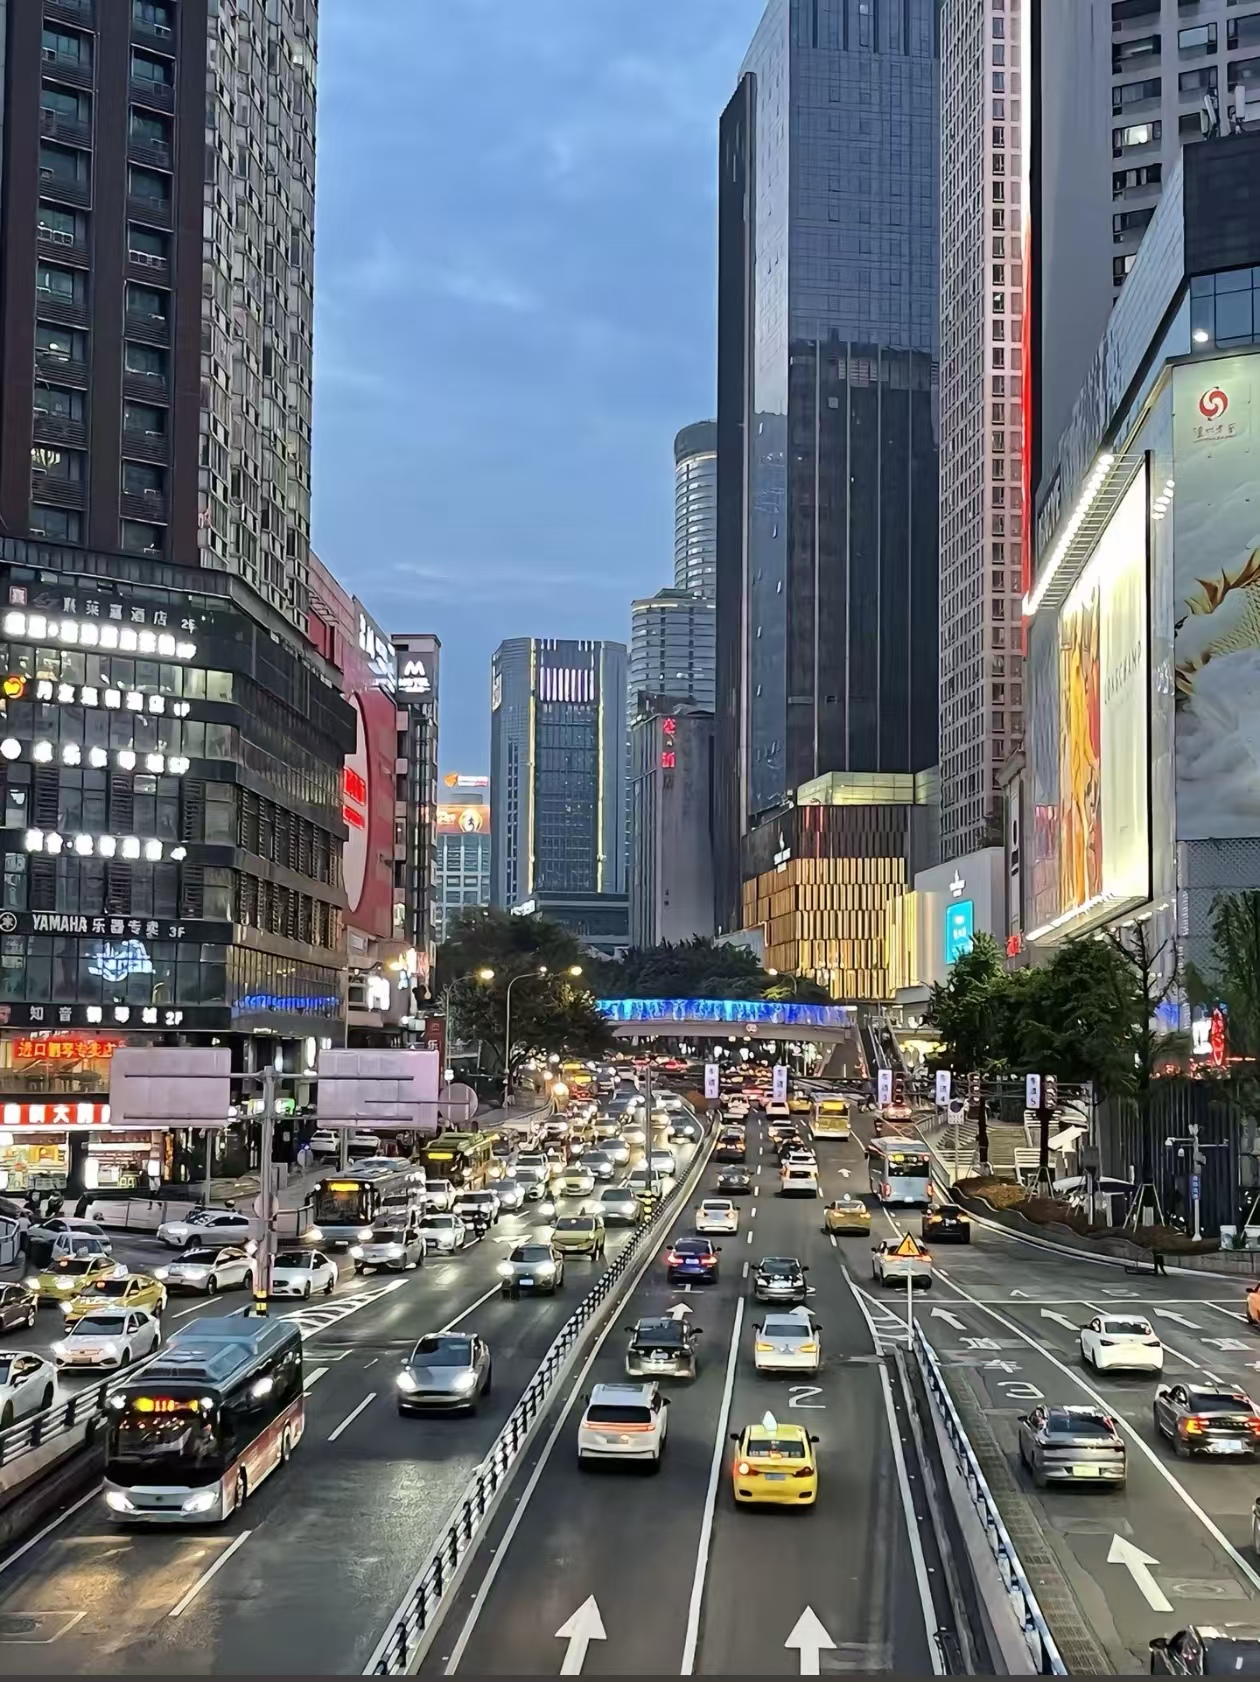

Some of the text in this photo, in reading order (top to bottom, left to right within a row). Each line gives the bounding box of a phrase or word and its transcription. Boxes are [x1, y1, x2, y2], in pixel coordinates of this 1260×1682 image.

[32, 913, 186, 939] YAMAHA 乐器专卖 3F
[166, 1011, 183, 1025] 2F
[789, 1385, 826, 1408] 2
[997, 1381, 1045, 1399] 3
